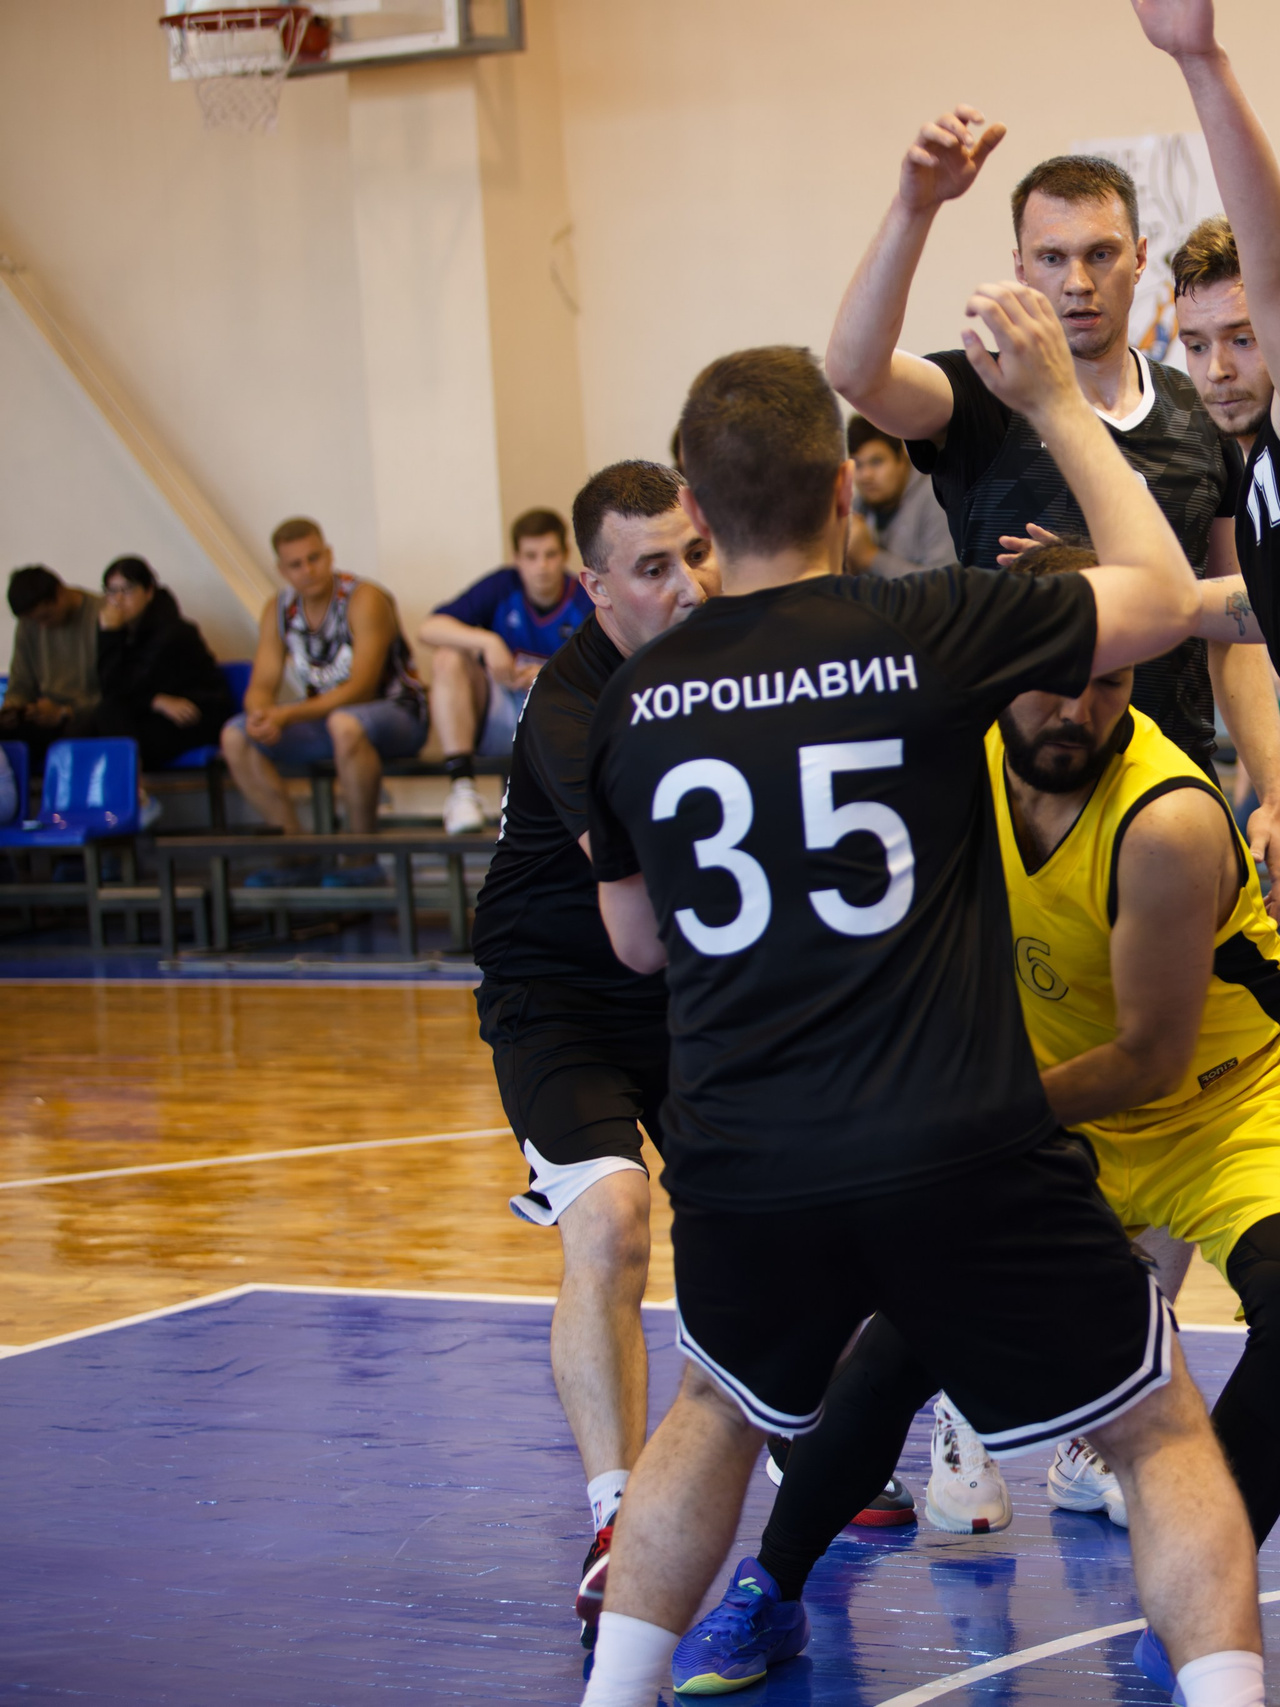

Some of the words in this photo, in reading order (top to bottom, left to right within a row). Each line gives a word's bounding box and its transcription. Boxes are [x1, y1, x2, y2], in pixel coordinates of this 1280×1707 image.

[630, 654, 918, 725] ХОРОШАВИН
[652, 738, 915, 956] 35
[1015, 936, 1069, 1001] 6
